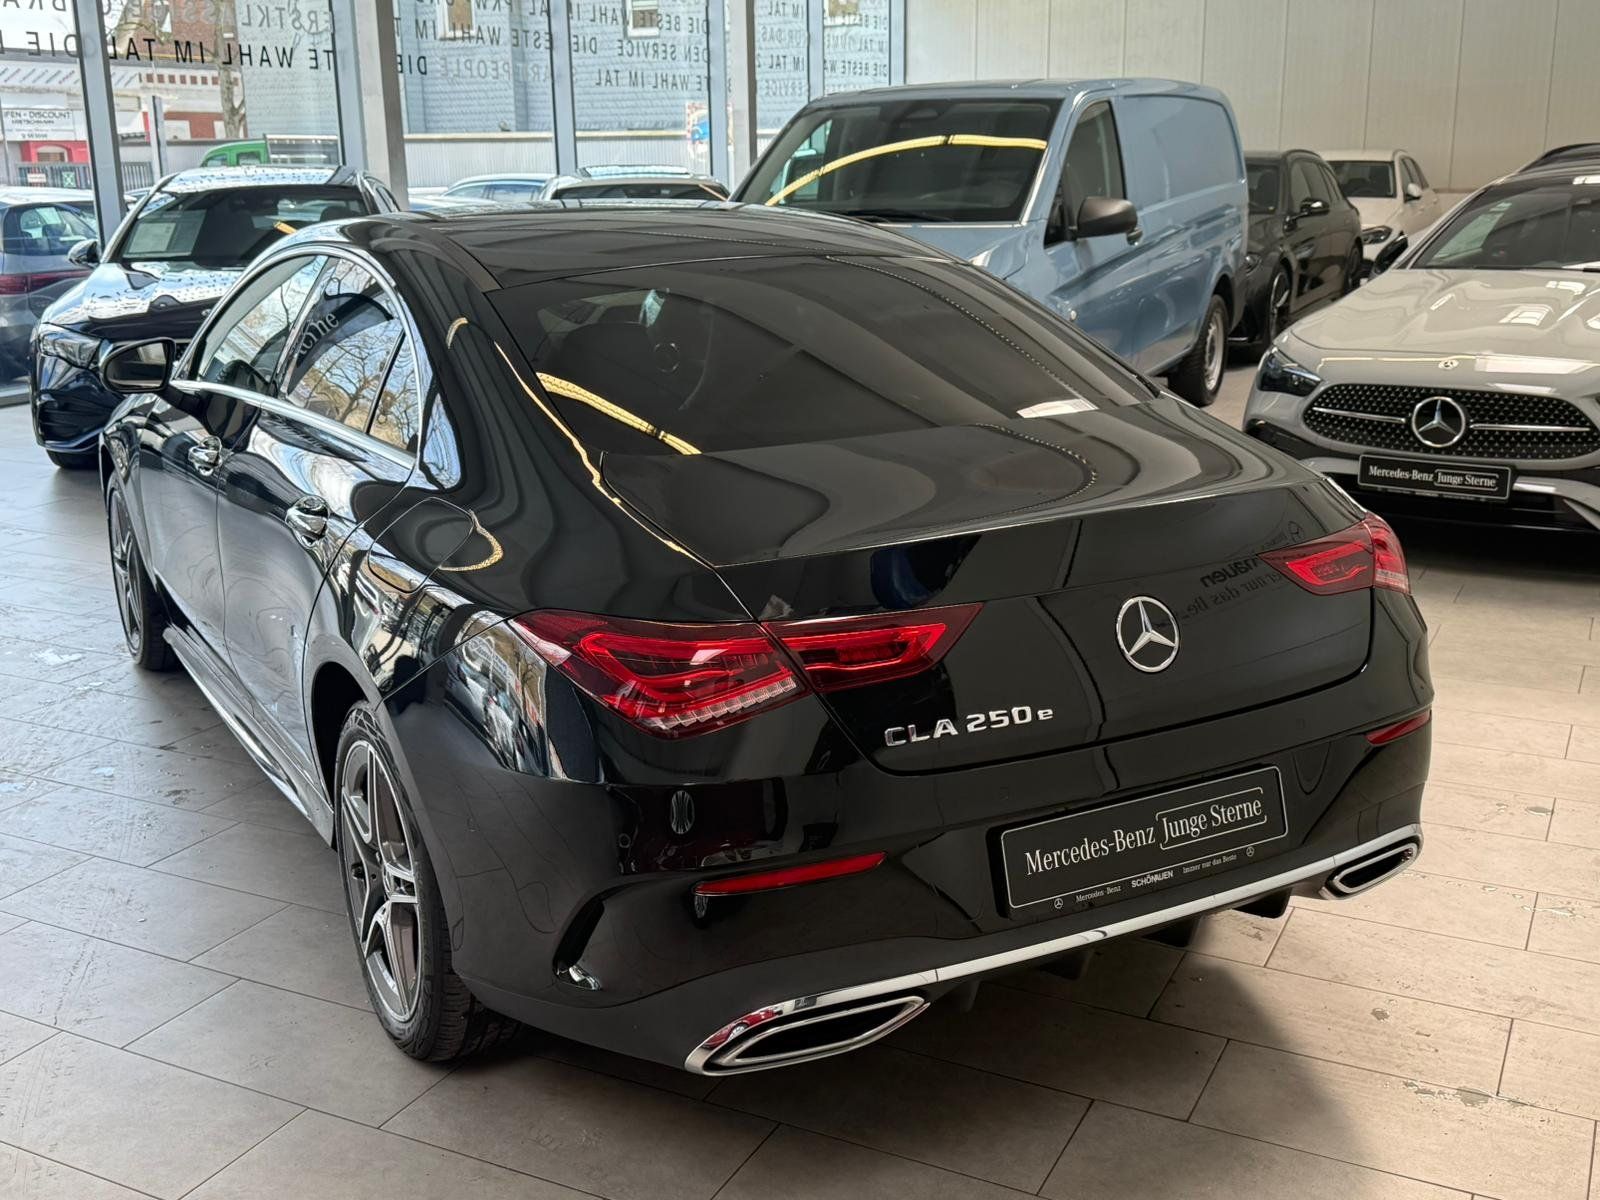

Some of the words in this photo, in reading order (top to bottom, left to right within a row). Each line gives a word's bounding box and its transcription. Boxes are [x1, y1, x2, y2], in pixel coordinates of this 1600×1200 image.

[1369, 465, 1434, 482] Mercedes-Benz
[1437, 472, 1463, 485] Junge
[1465, 474, 1496, 487] Sterne
[884, 718, 959, 747] CLA
[966, 705, 1032, 733] 250
[1024, 826, 1156, 876] Mercedes-Benz
[1162, 814, 1208, 844] Junge
[1210, 799, 1262, 828] Sterne
